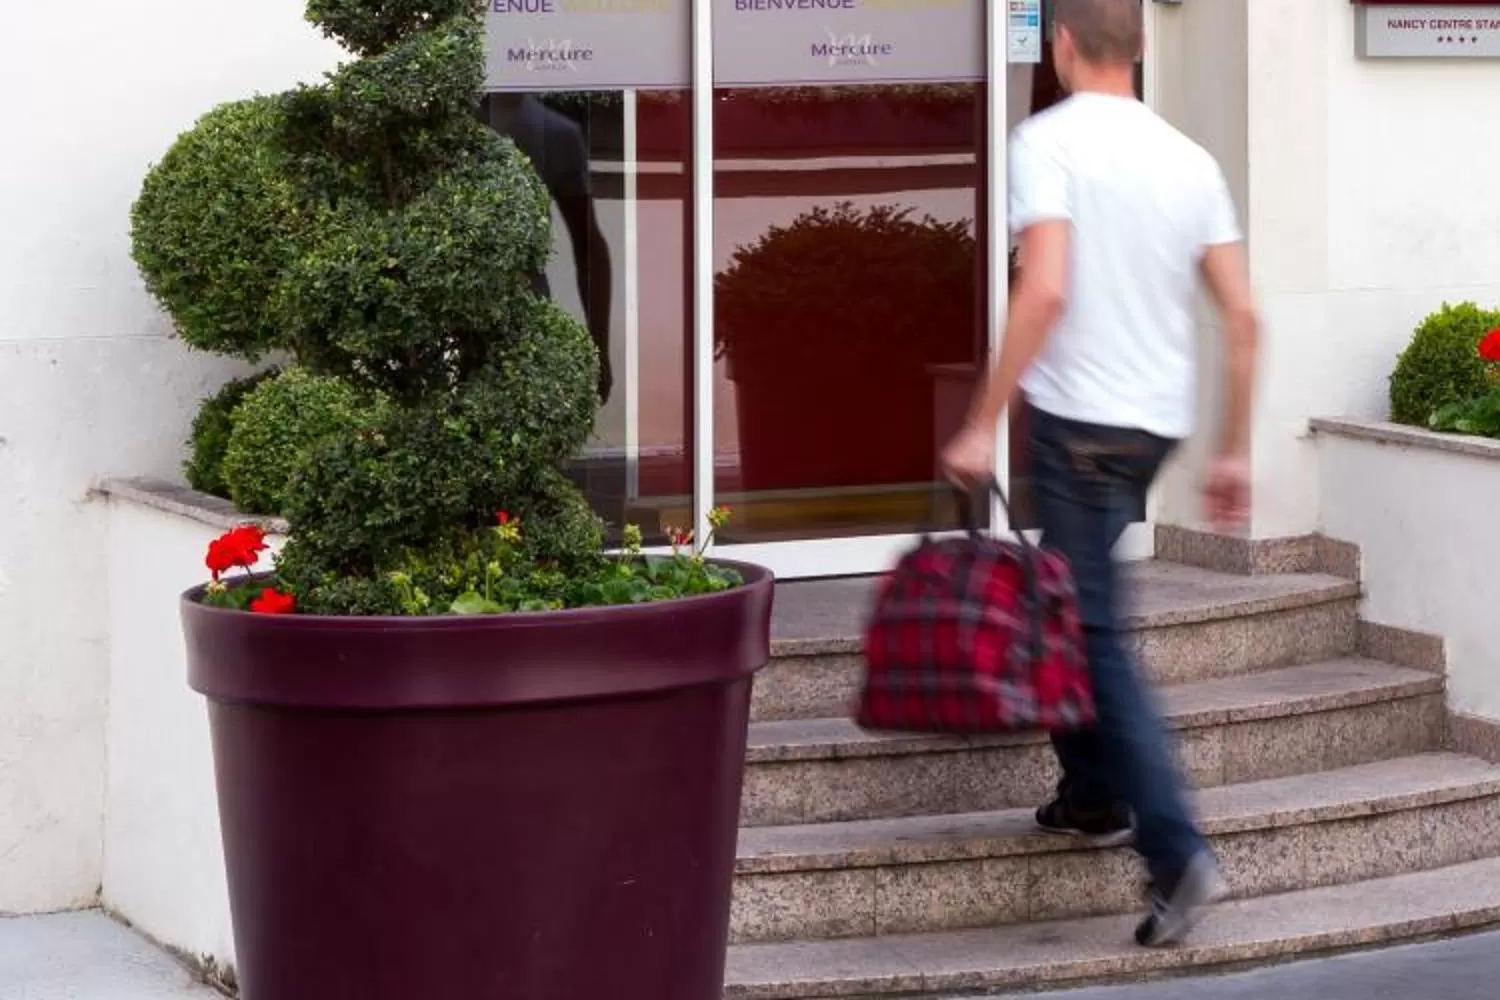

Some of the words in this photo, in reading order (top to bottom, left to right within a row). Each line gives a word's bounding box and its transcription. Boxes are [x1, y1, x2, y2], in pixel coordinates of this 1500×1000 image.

[1387, 18, 1427, 30] NANCY
[1429, 18, 1473, 30] CENTRE
[507, 46, 594, 62] Mercure
[810, 42, 893, 57] Mercure
